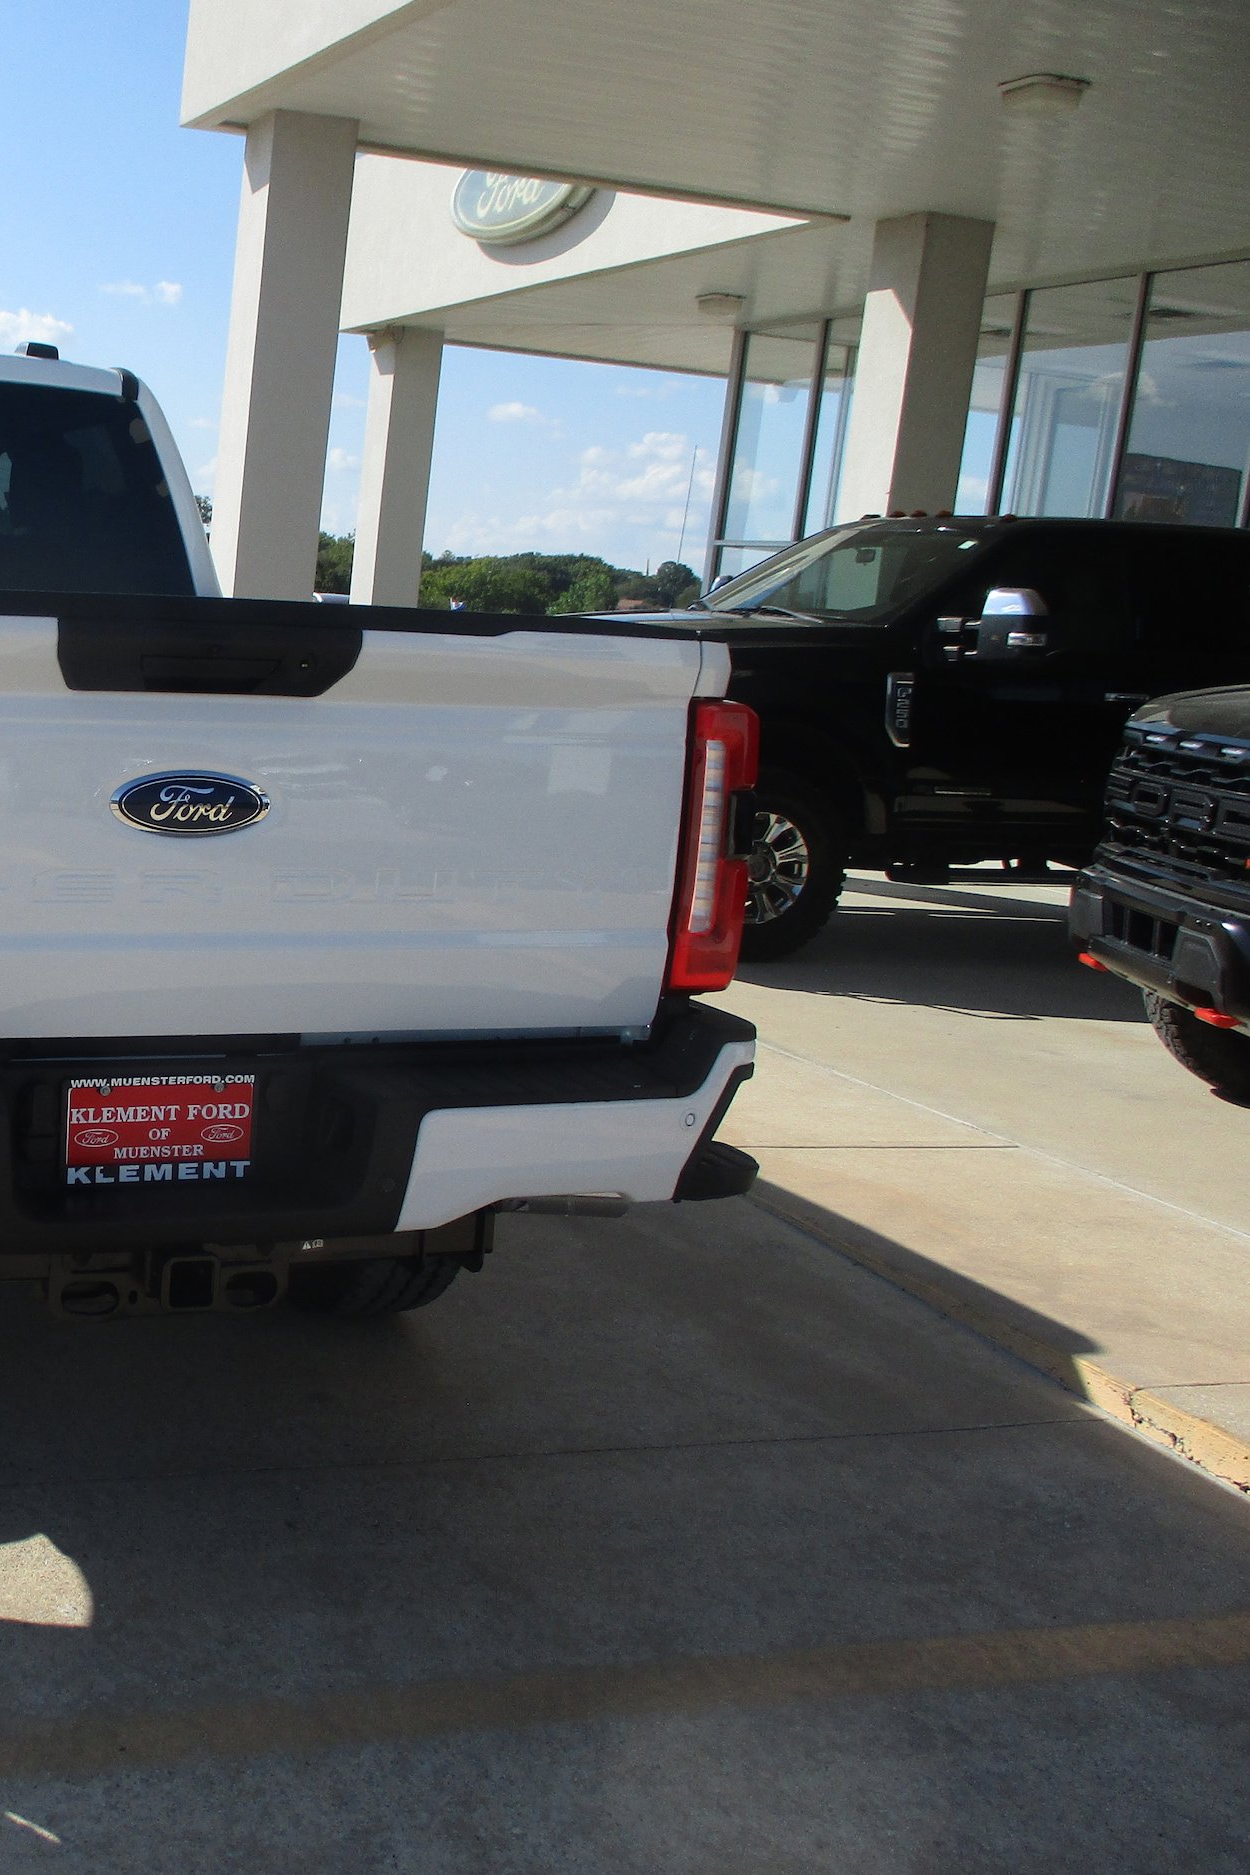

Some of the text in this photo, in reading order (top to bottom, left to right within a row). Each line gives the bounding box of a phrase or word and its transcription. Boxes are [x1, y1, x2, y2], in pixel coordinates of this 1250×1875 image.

[150, 784, 235, 822] Ford
[70, 1074, 255, 1088] WWW.MUENSTERFORD.COM
[70, 1103, 250, 1124] KLEMENT FORD
[81, 1131, 110, 1144] Ford
[148, 1128, 171, 1140] OF
[208, 1127, 235, 1140] Ford
[113, 1144, 204, 1159] MUENSTER
[67, 1161, 250, 1184] KLEMENT
